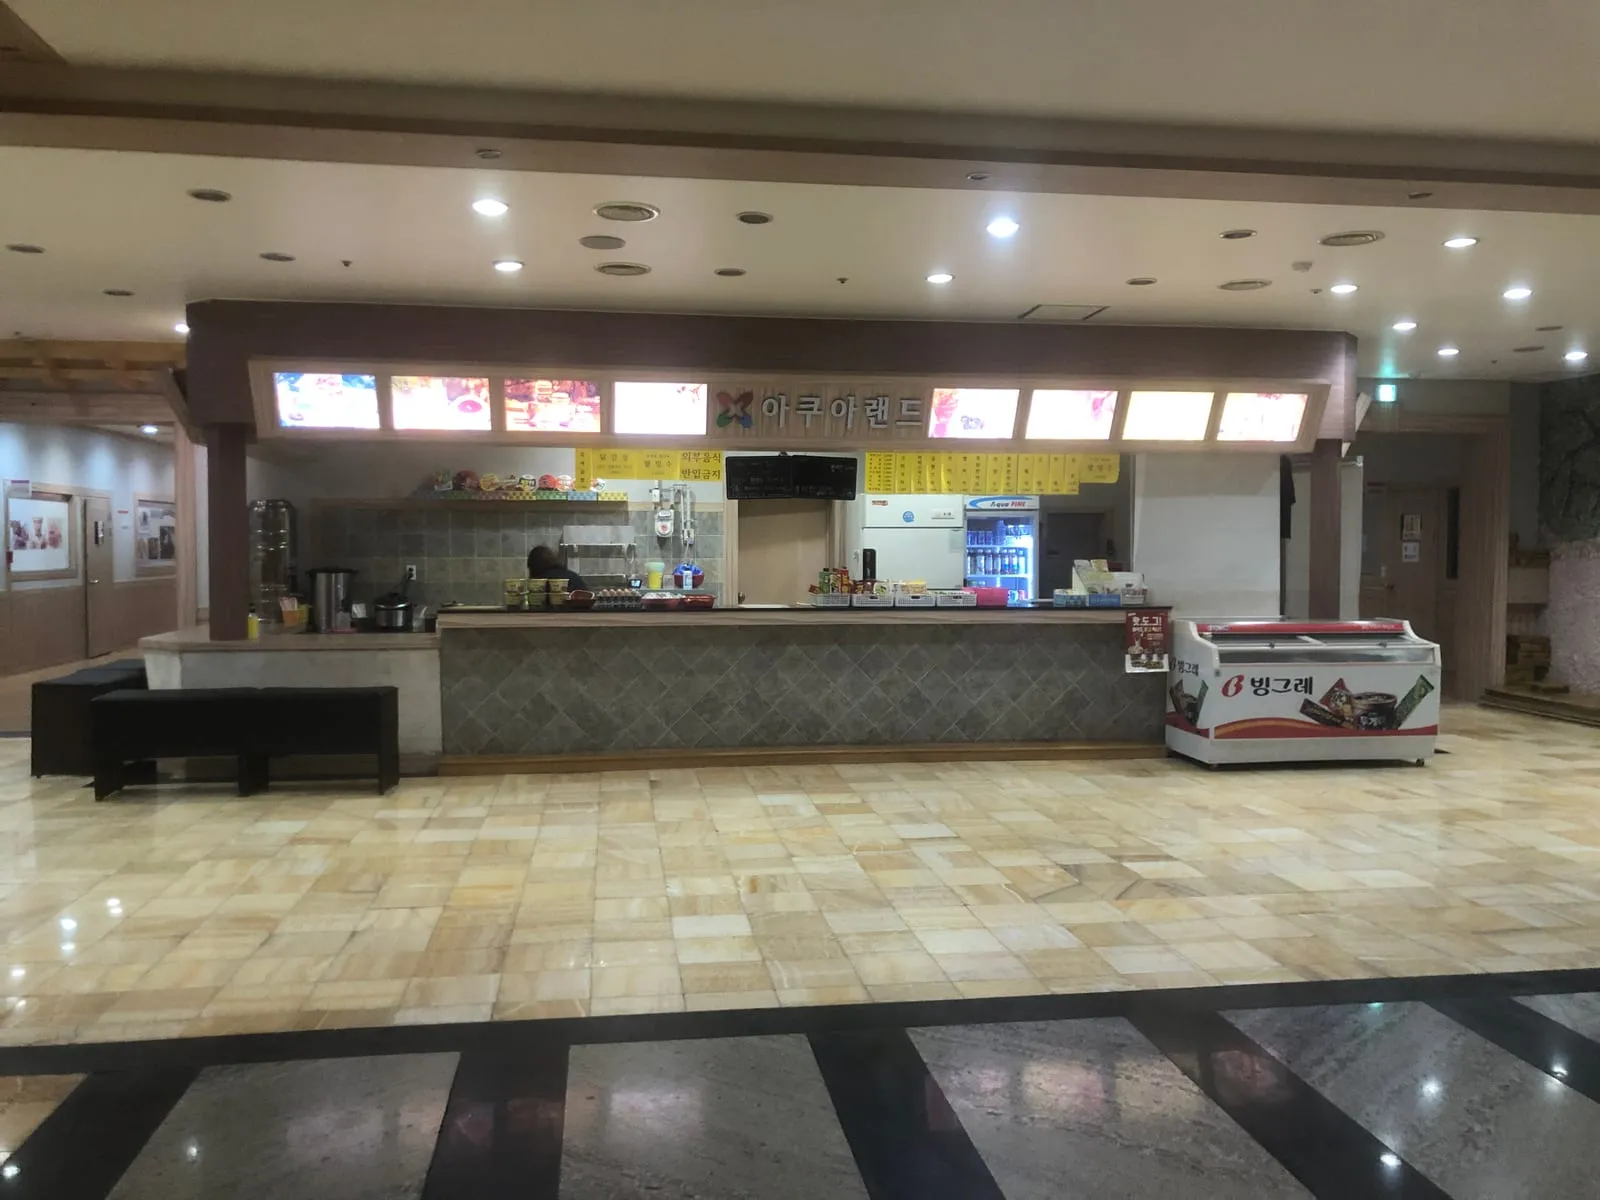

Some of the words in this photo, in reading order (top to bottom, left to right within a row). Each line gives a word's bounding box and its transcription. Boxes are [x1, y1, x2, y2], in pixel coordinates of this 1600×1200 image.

[762, 394, 923, 429] 아쿠아랜드
[681, 469, 721, 480] 반입금지
[1177, 660, 1199, 676] 빙그레
[1250, 676, 1313, 697] 빙그레
